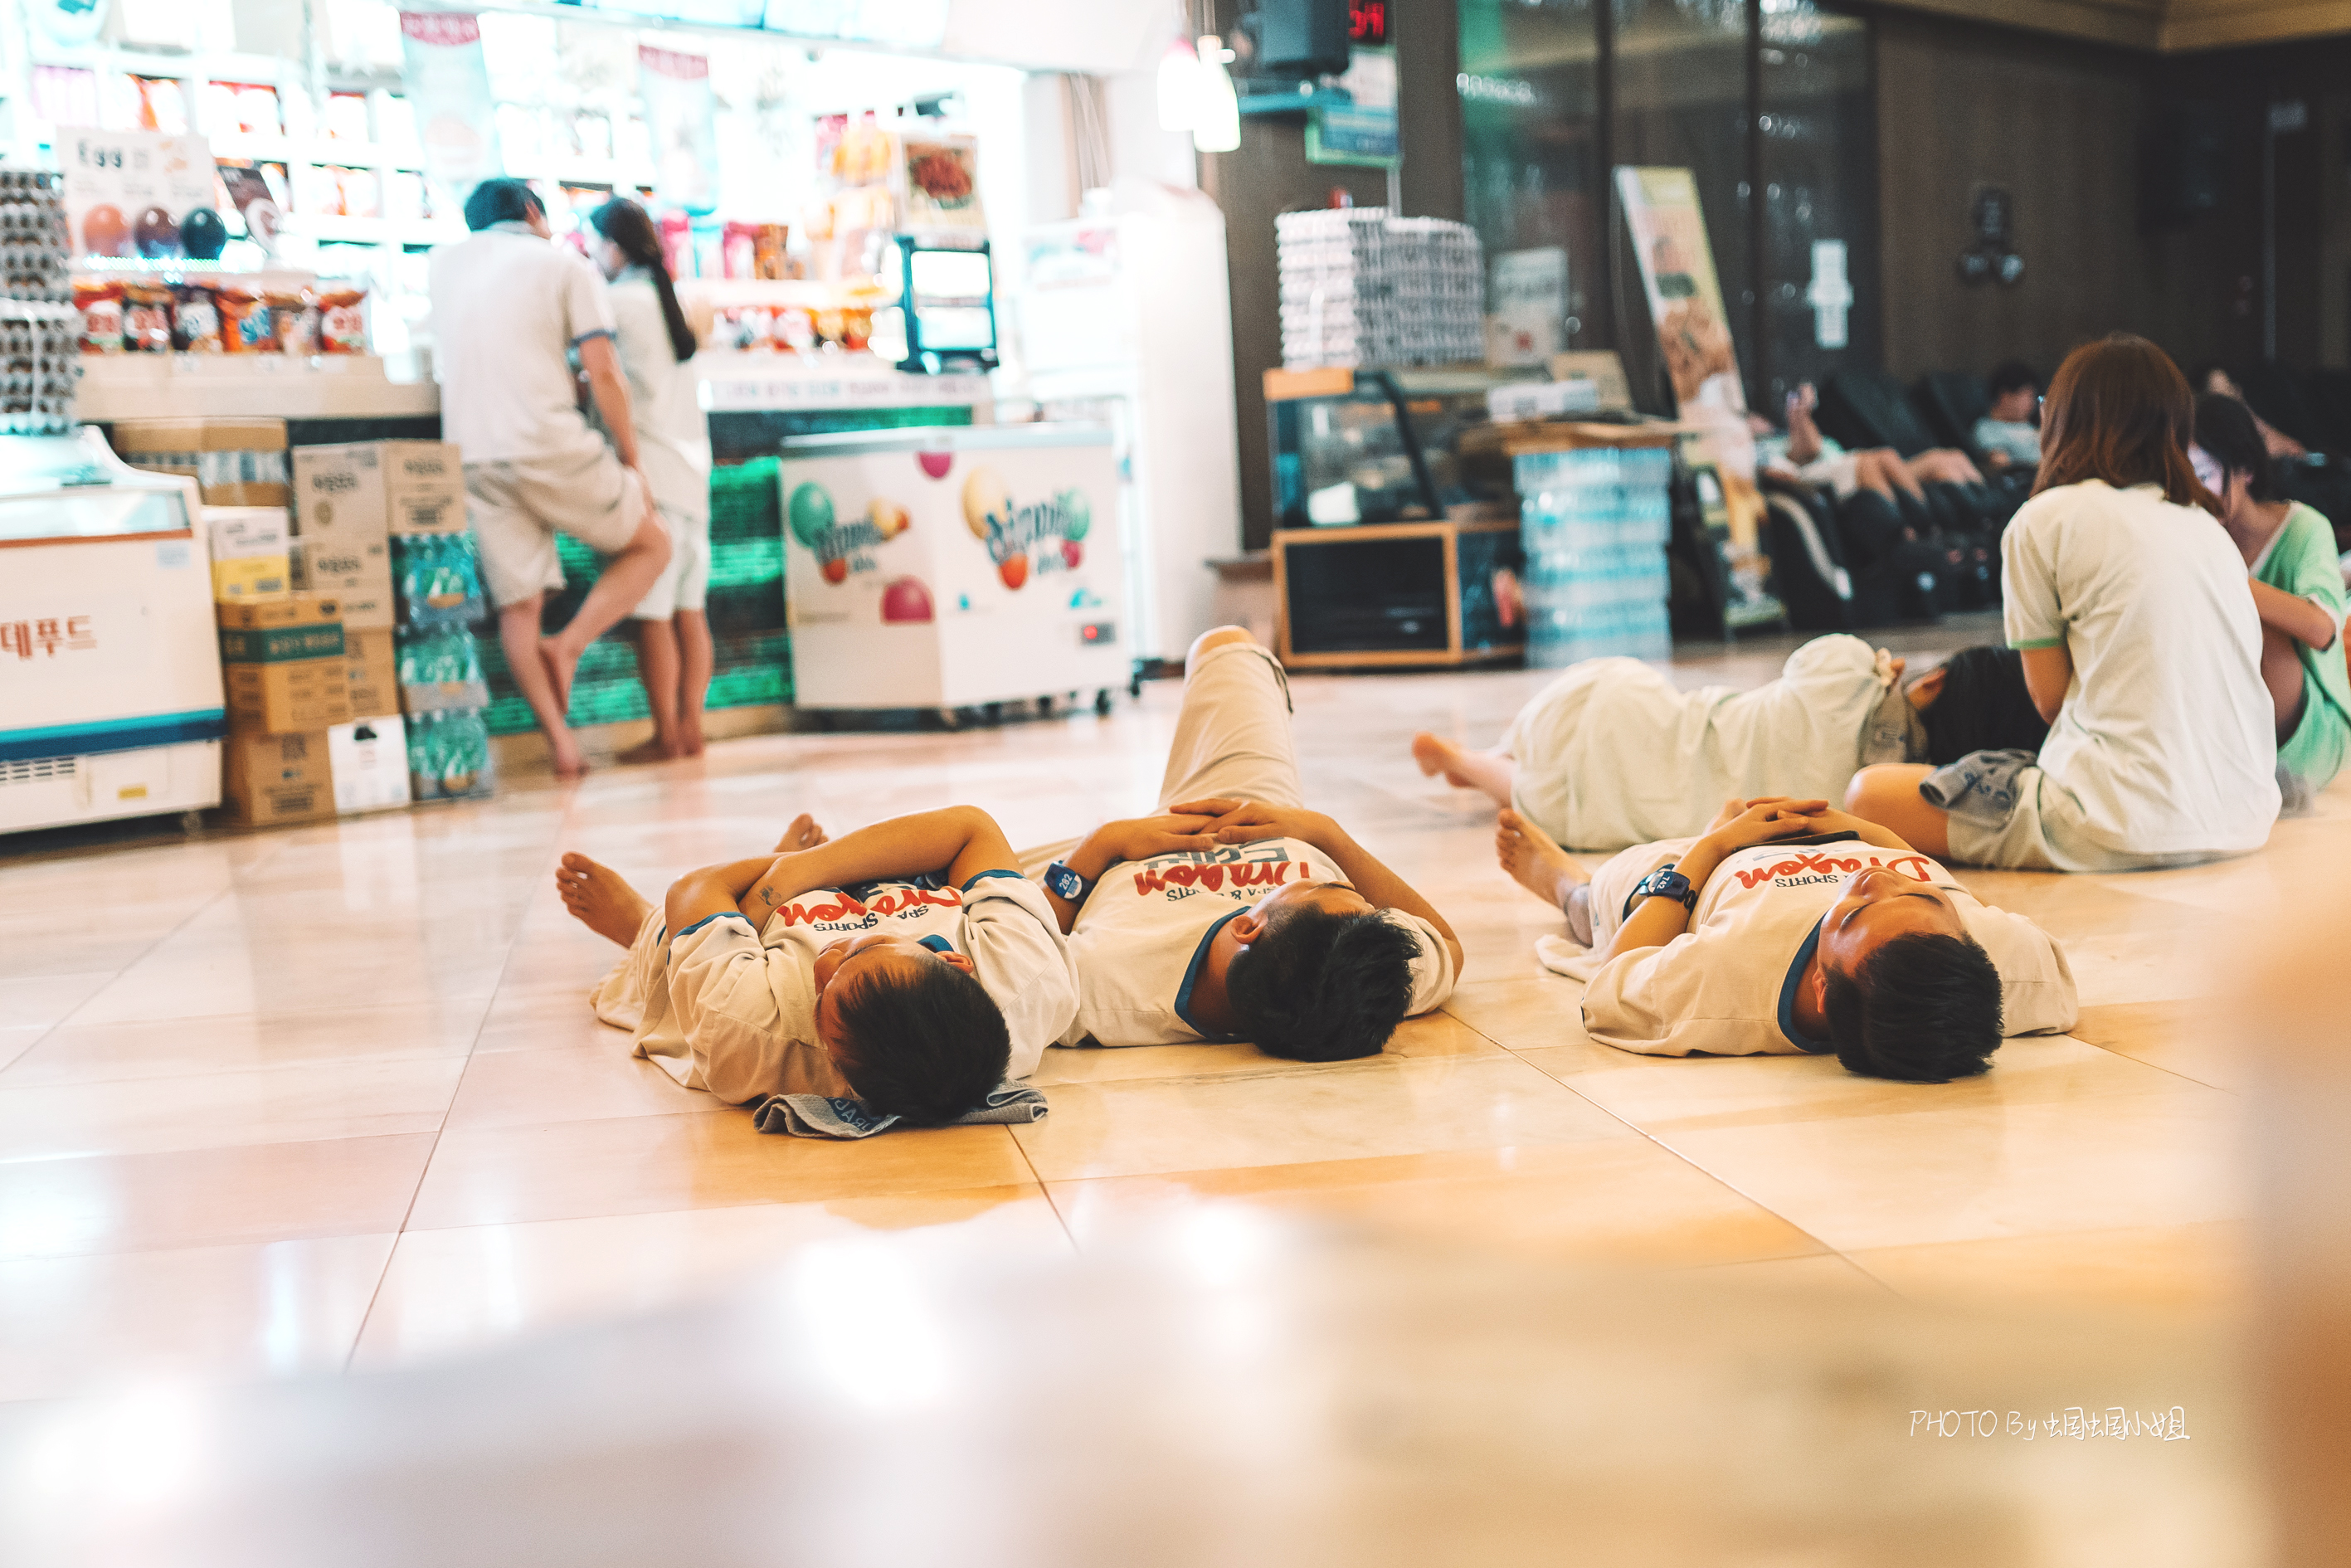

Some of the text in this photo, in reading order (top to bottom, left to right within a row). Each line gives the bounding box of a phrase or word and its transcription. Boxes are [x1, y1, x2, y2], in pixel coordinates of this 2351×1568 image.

[1774, 874, 1839, 888] SPORTS
[813, 905, 929, 932] SPA SPORTS
